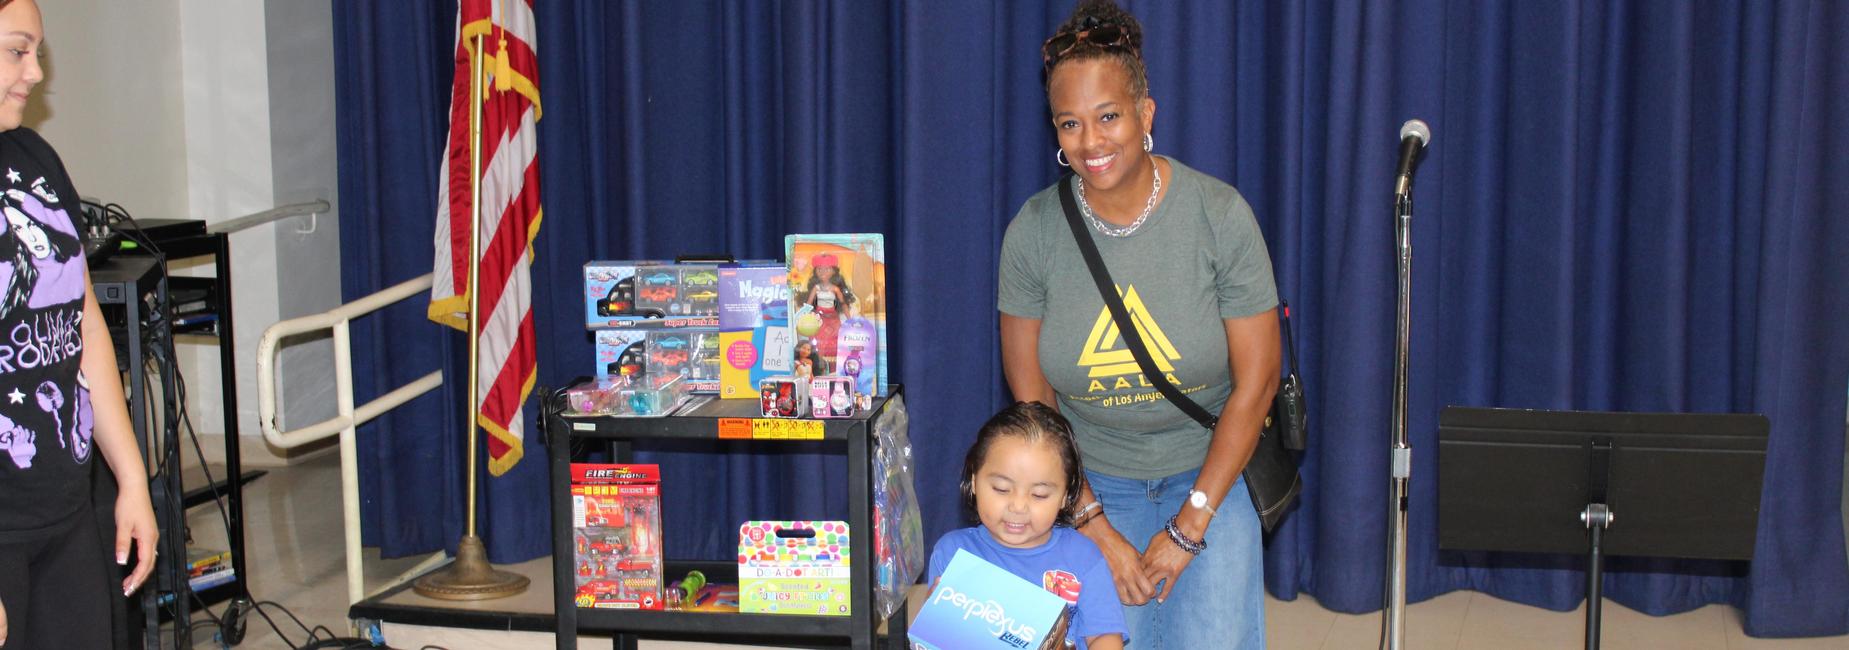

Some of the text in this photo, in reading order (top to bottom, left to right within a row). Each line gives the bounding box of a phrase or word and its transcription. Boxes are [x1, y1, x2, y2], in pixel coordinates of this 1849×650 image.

[738, 279, 788, 304] Magic
[764, 358, 782, 367] one
[1102, 396, 1113, 407] of
[1115, 395, 1132, 405] Los
[586, 469, 613, 478] FIRE
[933, 586, 1038, 641] perplexus
[998, 631, 1030, 650] REBEL
